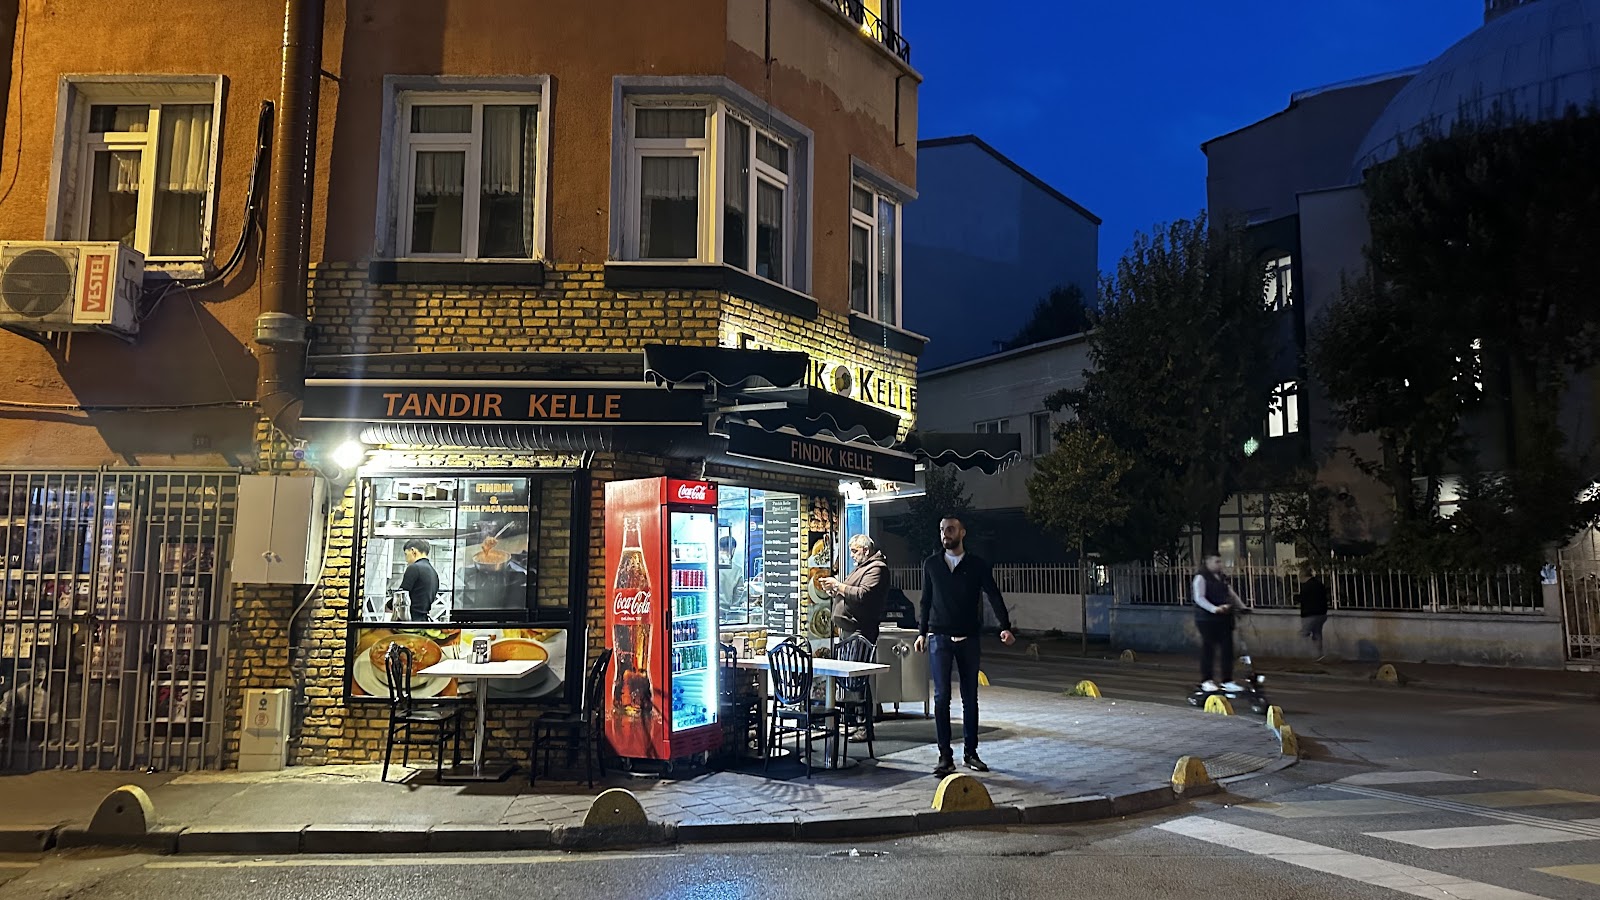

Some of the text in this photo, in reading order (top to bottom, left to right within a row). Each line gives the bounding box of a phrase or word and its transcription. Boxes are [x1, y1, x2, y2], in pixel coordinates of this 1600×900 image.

[86, 256, 105, 311] VESTEL
[383, 393, 621, 418] TANDIR KELLE
[791, 440, 873, 472] FINDIK KELLE
[476, 483, 513, 493] FINDIK
[614, 591, 651, 615] Coca-Cola
